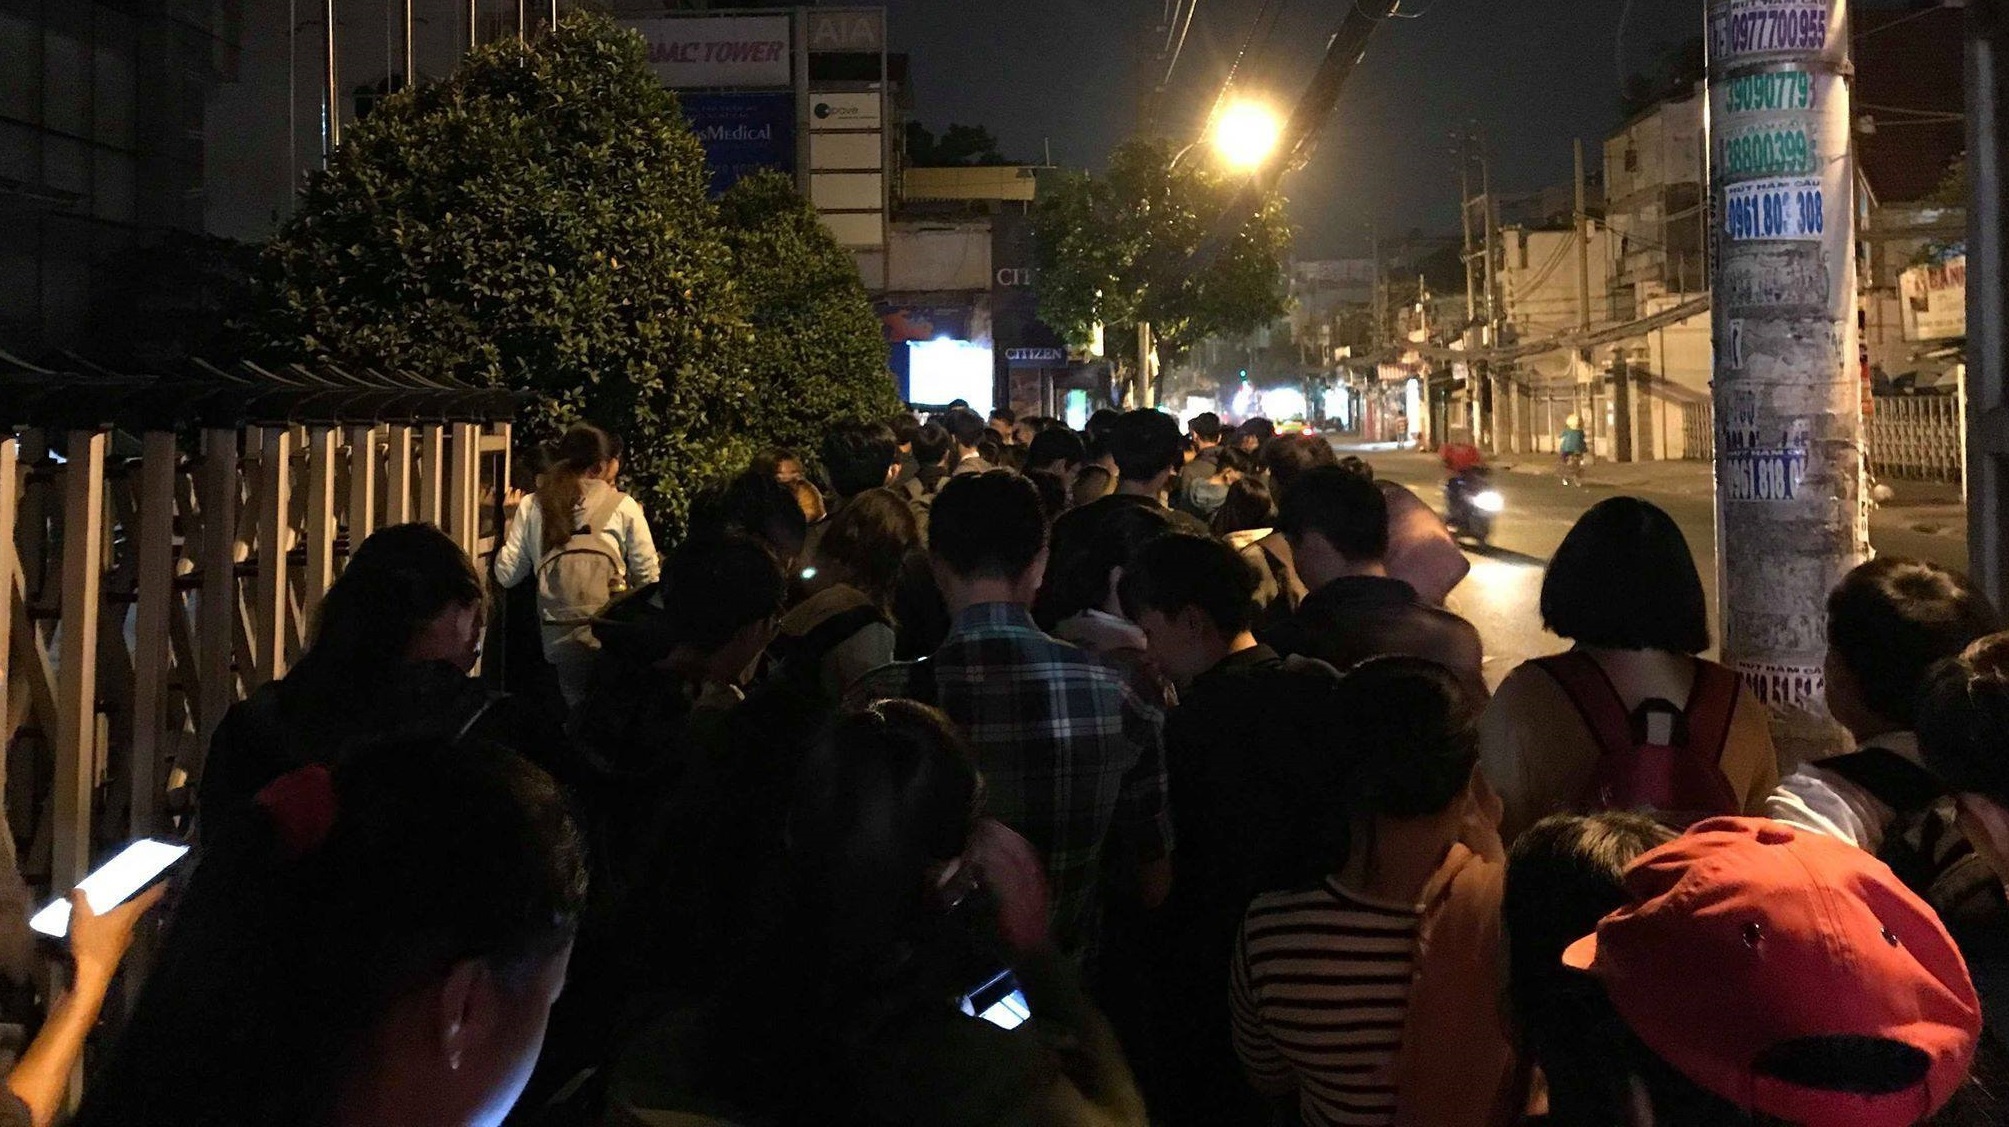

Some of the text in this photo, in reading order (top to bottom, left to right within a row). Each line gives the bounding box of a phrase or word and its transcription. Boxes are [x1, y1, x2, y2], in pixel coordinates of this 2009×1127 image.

[814, 17, 876, 44] AIA
[704, 41, 784, 63] TOWER
[1005, 347, 1063, 360] CITIZEN
